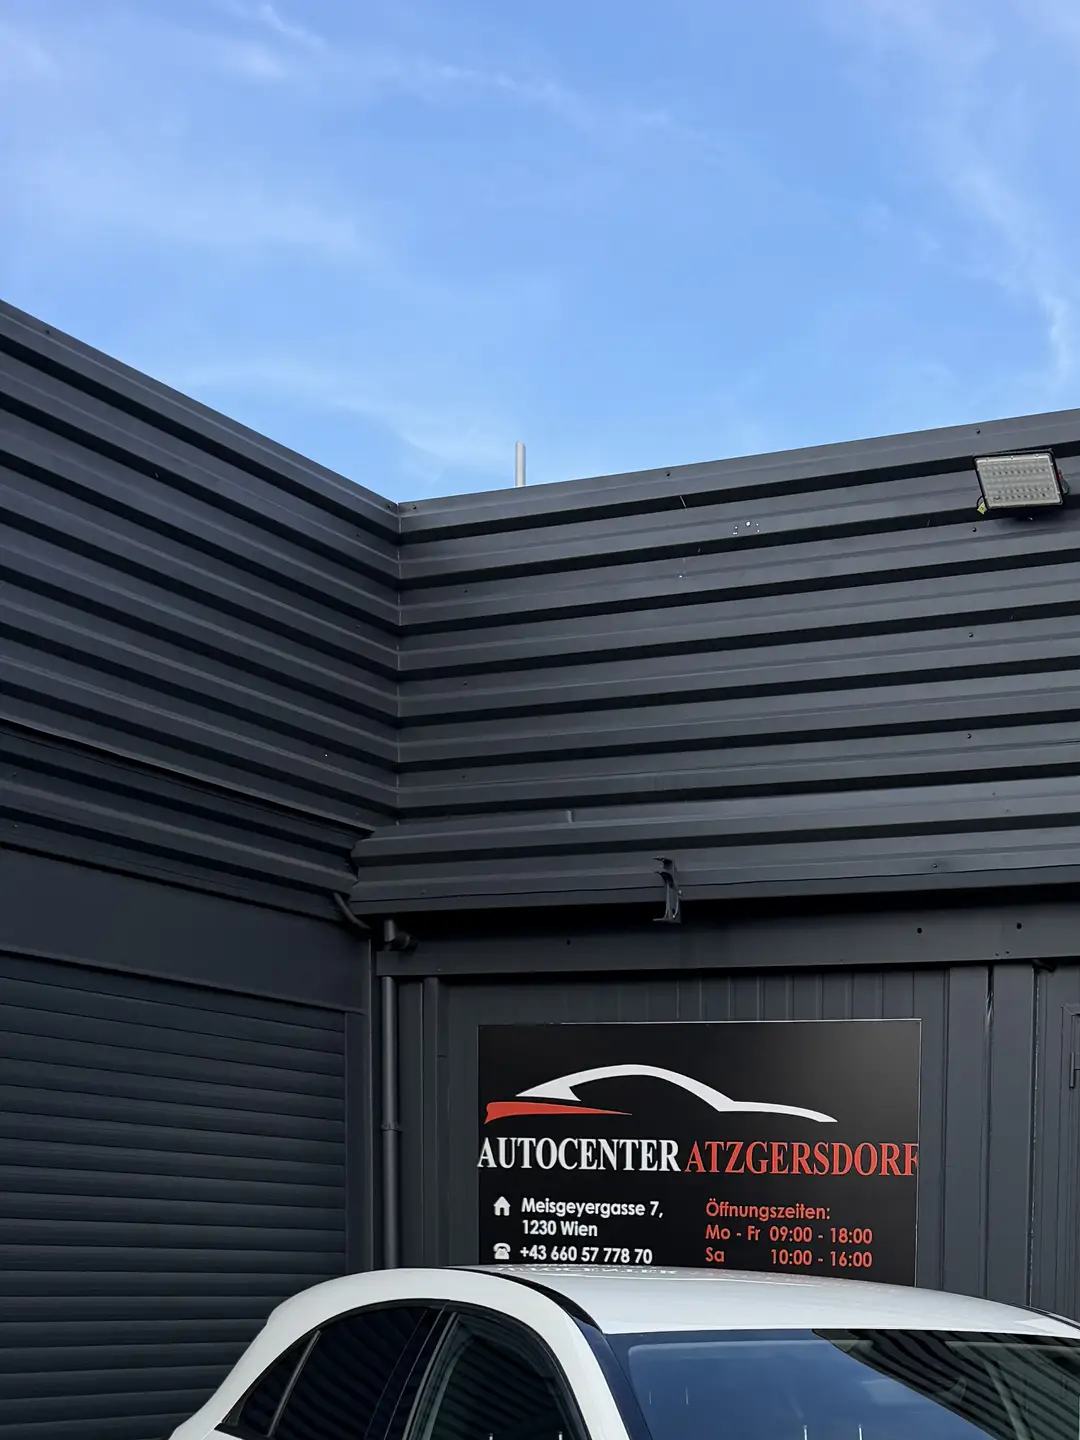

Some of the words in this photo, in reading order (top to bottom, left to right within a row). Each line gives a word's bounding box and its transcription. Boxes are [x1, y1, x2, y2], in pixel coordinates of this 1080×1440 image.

[477, 1138, 681, 1171] AUTOCENTER
[685, 1140, 919, 1176] ATZGERSDORF
[522, 1198, 645, 1218] Meisgeyergasse
[650, 1201, 663, 1218] 7,
[706, 1198, 830, 1221] Öffnungszeiten:
[523, 1220, 556, 1235] 1230
[561, 1221, 597, 1236] Wien
[706, 1225, 730, 1239] Mo
[748, 1226, 760, 1240] Fr
[770, 1226, 812, 1242] 09:00
[831, 1228, 872, 1244] 18:00
[520, 1245, 549, 1260] +43
[551, 1246, 577, 1261] 660
[581, 1247, 599, 1261] 57
[601, 1248, 630, 1263] 778
[635, 1249, 652, 1264] 70
[706, 1247, 724, 1262] Sa
[771, 1249, 812, 1265] 10:00
[831, 1251, 872, 1267] 16:00
